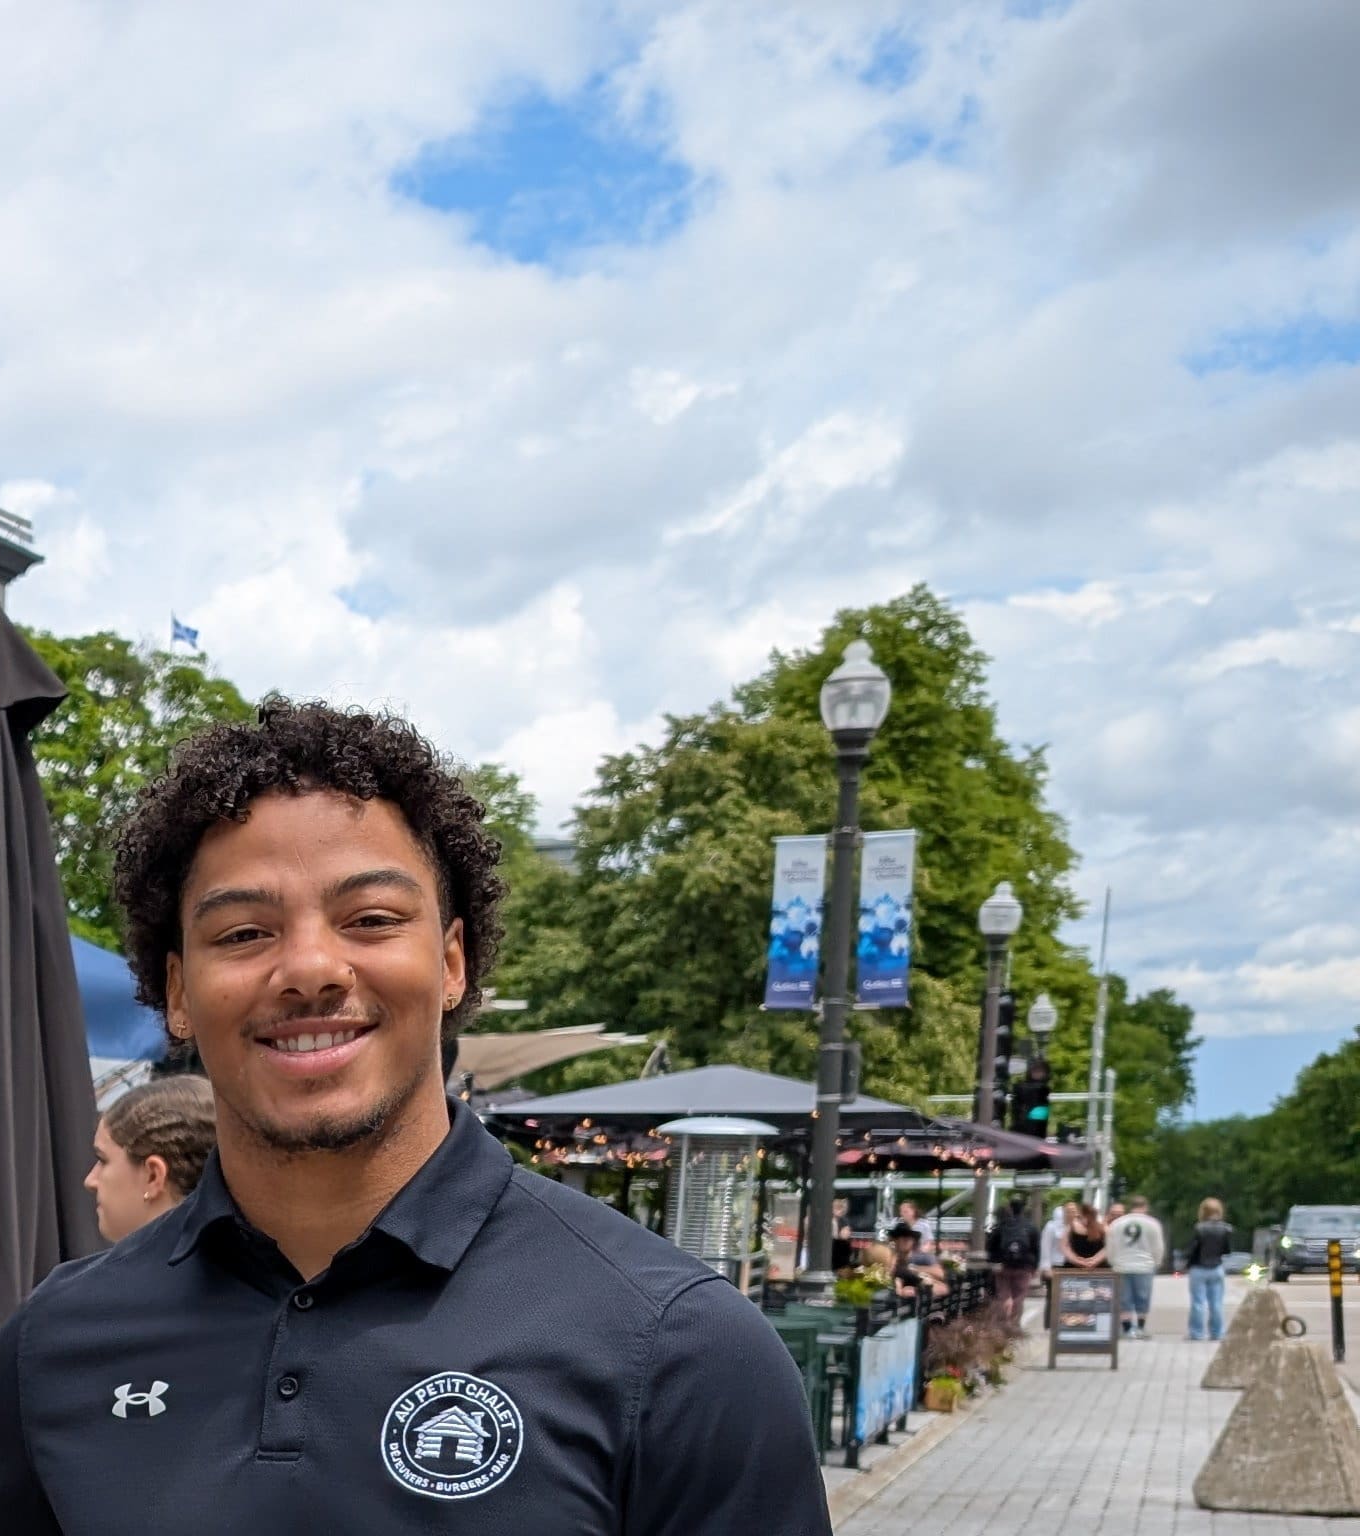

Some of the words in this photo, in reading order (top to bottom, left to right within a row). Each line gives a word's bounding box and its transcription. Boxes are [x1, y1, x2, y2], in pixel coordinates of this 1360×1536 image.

[1123, 1222, 1142, 1246] 9
[394, 1398, 416, 1424] AU
[414, 1377, 466, 1404] PETIT
[465, 1383, 517, 1430] CHALET
[435, 1475, 490, 1493] BURGERS
[490, 1452, 511, 1475] BAR
